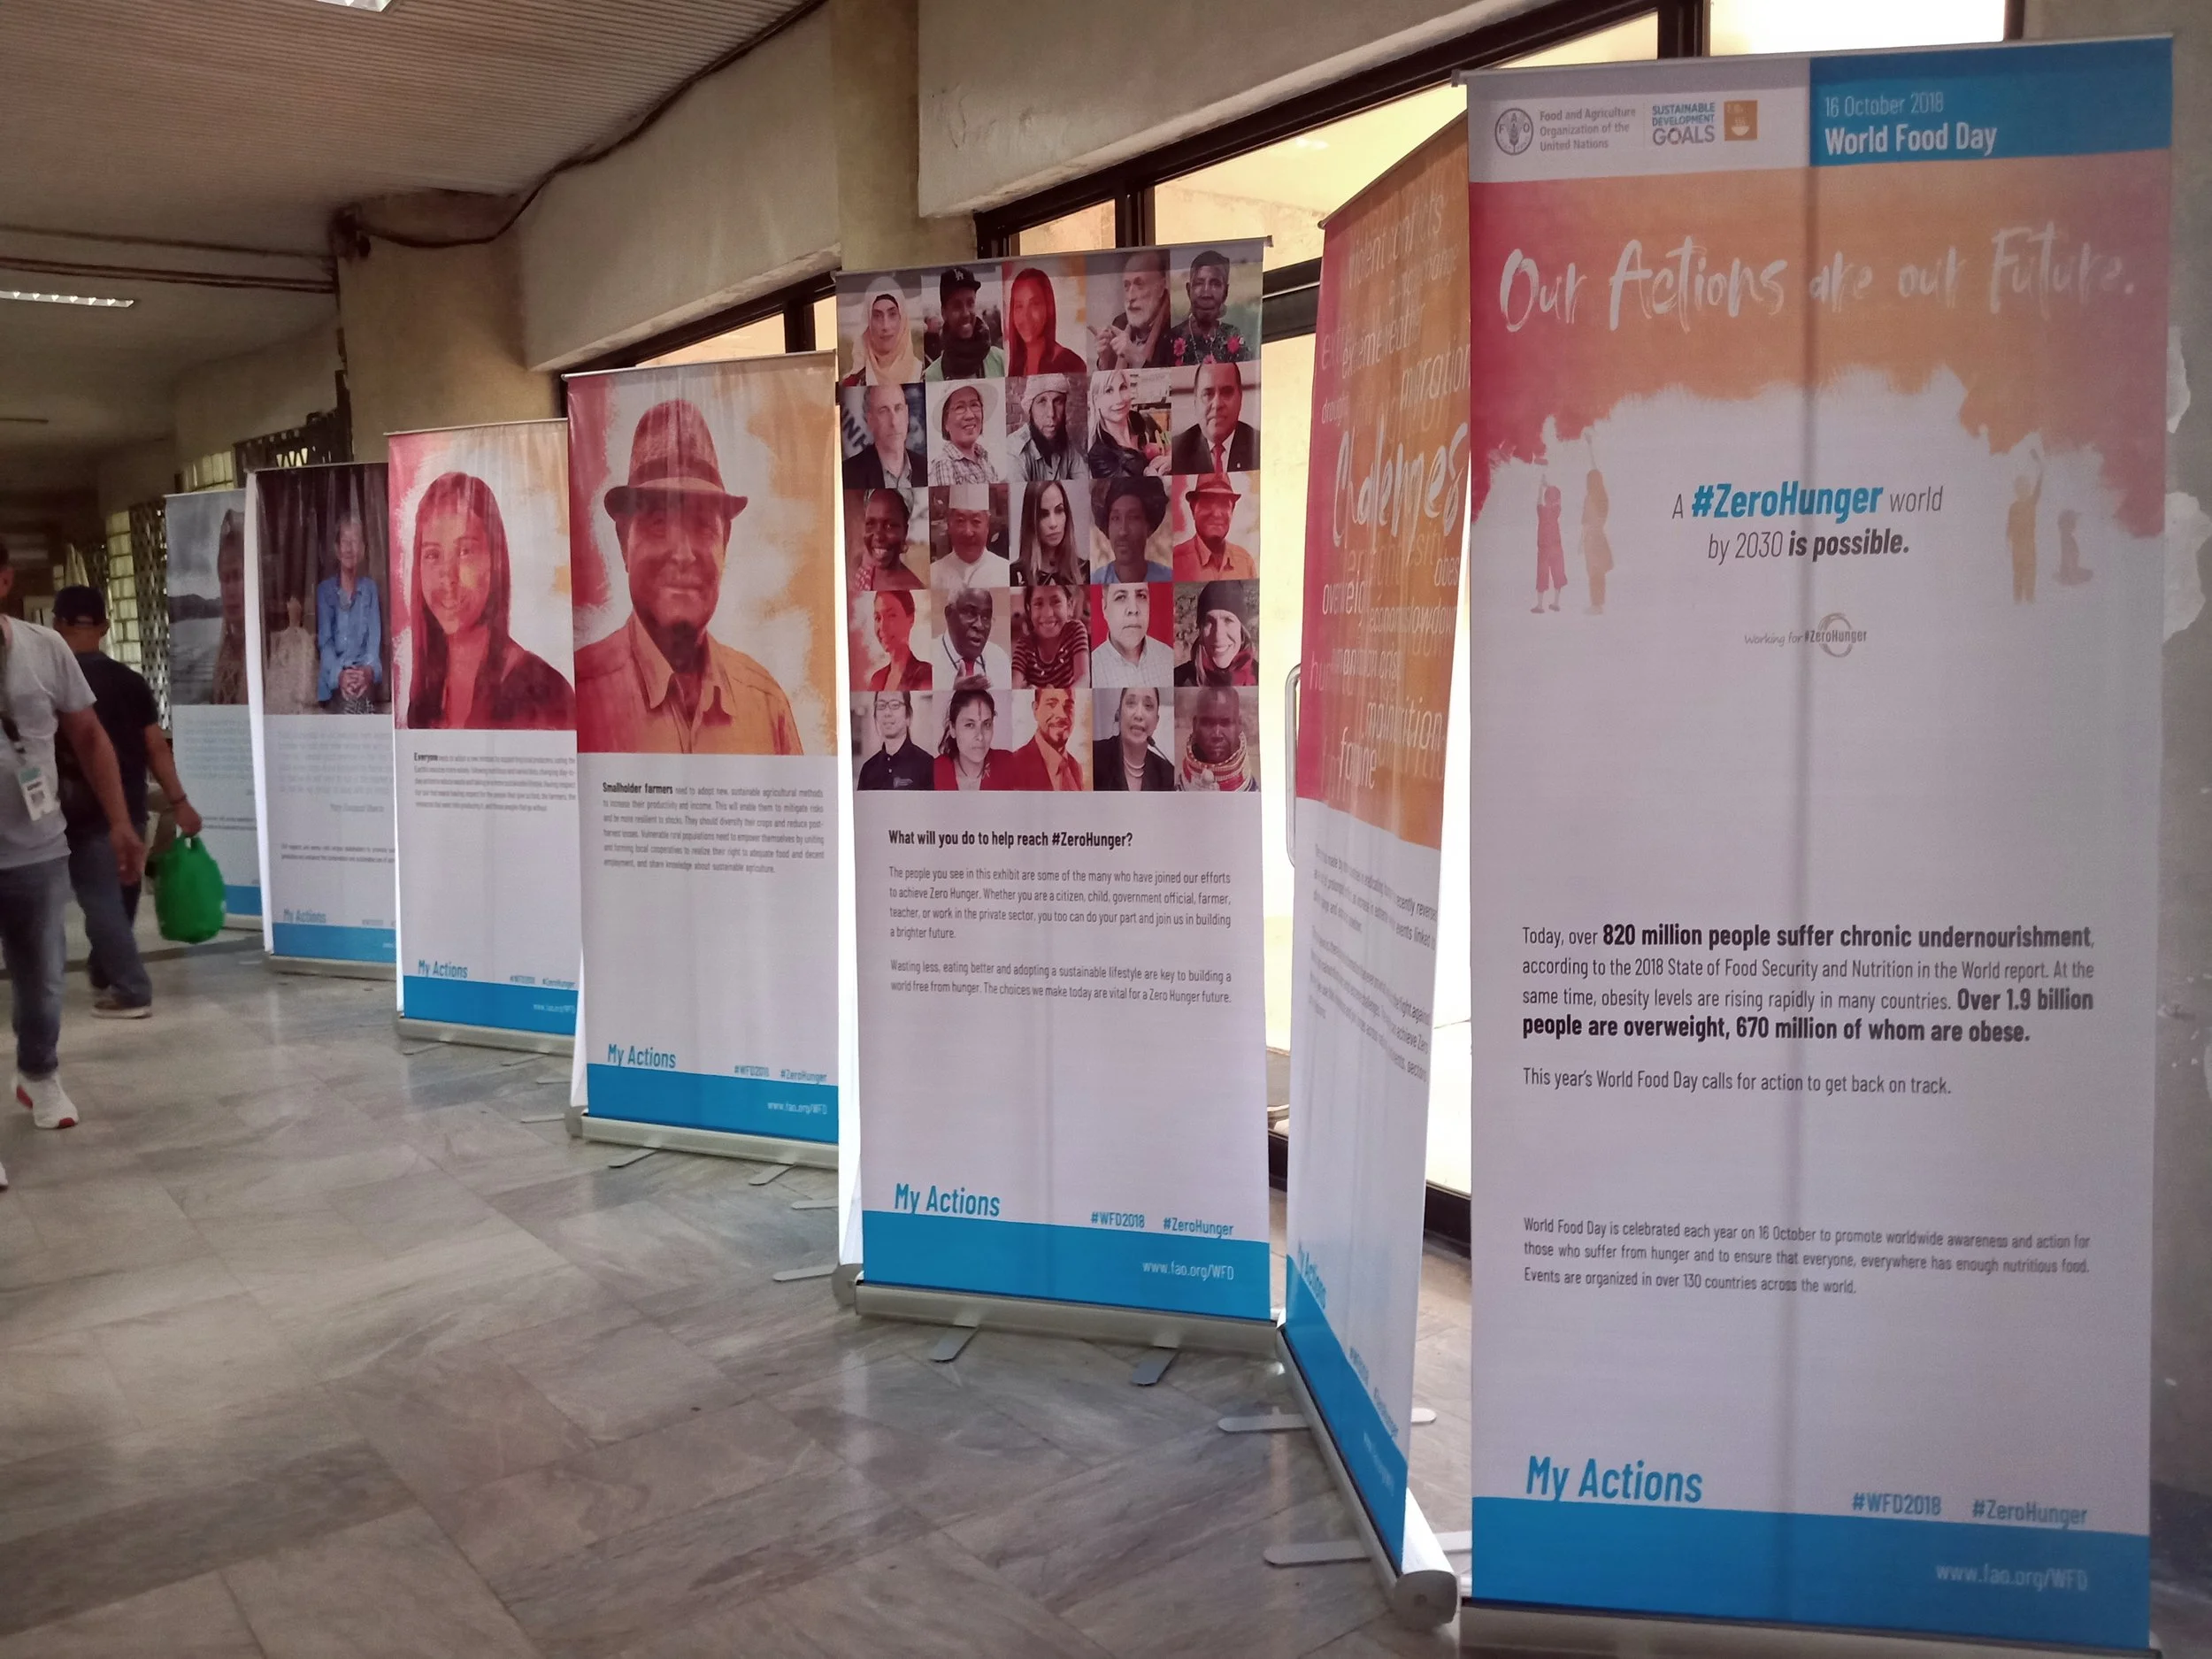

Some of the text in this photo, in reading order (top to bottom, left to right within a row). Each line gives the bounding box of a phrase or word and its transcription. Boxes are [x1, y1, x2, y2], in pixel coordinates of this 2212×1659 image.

[1540, 106, 1636, 122] Food and Agriculture
[1652, 102, 1716, 115] SUSTAINABLE
[1825, 92, 1944, 117] 16 October 2018
[1540, 122, 1630, 139] Organization of the
[1652, 113, 1715, 127] DEVELOPMENT
[1540, 138, 1609, 152] United Nations
[1652, 125, 1716, 146] GOALS
[1824, 121, 1998, 157] World Food Day
[1500, 249, 1587, 332] Our
[1609, 235, 1787, 334] Actions
[1809, 250, 1874, 313] are
[1898, 246, 1967, 308] our
[1990, 220, 2135, 322] Future.
[1672, 480, 1943, 524] A #ZeroHunger world
[1708, 528, 1909, 565] by 2030 is possible.
[1744, 629, 1867, 648] Working for #ZeroHunger
[603, 782, 673, 794] Smallholder farmers
[888, 830, 1133, 850] What will you do to help reach #ZeroHunger?
[889, 866, 902, 878] The
[905, 868, 930, 881] people
[933, 871, 948, 881] you
[966, 868, 973, 878] in
[976, 868, 991, 879] this
[993, 868, 1019, 879] exhibit
[1022, 872, 1035, 880] are
[1038, 872, 1059, 880] some
[1062, 870, 1070, 881] of
[1072, 870, 1086, 881] the
[1088, 872, 1112, 885] many
[1114, 871, 1131, 882] who
[1133, 871, 1153, 882] have
[1155, 872, 1180, 886] joined
[1184, 874, 1198, 883] our
[1201, 872, 1230, 884] efforts
[1523, 927, 1563, 949] Today,
[1569, 932, 1598, 945] over
[1603, 924, 1635, 945] 820
[1642, 923, 1701, 945] million
[1709, 925, 1770, 951] people
[1778, 925, 1834, 946] suffer
[1840, 925, 1911, 947] chronic
[418, 959, 468, 979] My Actions
[1523, 957, 2094, 983] according to the 2018 State of Food Security and Nutrition in the World report. At the
[1523, 987, 2093, 1013] same time, obesity levels are rising rapidly in many countries. Over 1.9 billion
[1524, 1014, 2030, 1042] people are overweight, 670 million of whom are obese.
[608, 1044, 676, 1068] My Actions
[1524, 1067, 1951, 1096] This year's World Food Day calls for action to get back on track.
[895, 1183, 1001, 1217] My Actions
[1091, 1211, 1233, 1239] #WFD2018 #ZeroHunger
[1142, 1260, 1234, 1282] www.fao.org/WFD
[1525, 1267, 1560, 1283] Events
[1564, 1273, 1581, 1284] are
[1586, 1271, 1638, 1288] organized
[1642, 1276, 1652, 1286] in
[1656, 1276, 1679, 1286] over
[1683, 1273, 1701, 1288] 130
[1705, 1276, 1756, 1290] countries
[1761, 1279, 1797, 1292] across
[1801, 1279, 1819, 1292] the
[1526, 1455, 1702, 1503] My Actions
[1853, 1492, 2088, 1529] #WFD2018 #ZeroHunger
[1935, 1562, 2088, 1593] www.fao.org/WFD
